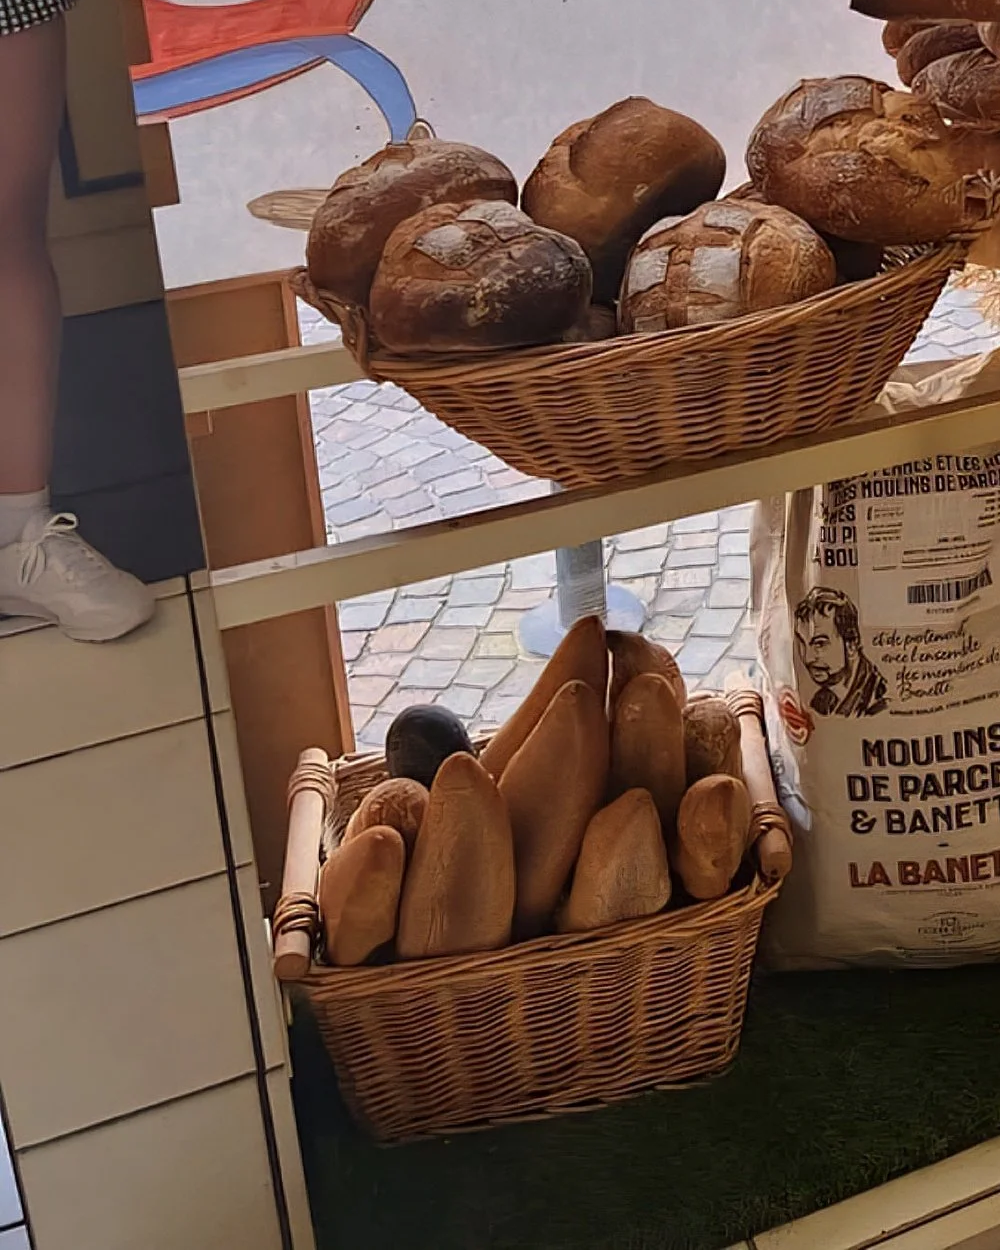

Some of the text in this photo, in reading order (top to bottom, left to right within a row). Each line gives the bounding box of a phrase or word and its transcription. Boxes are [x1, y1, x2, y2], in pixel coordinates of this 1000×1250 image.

[861, 474, 930, 499] MOULINS
[935, 474, 956, 492] DE
[846, 774, 892, 803] DE
[850, 808, 877, 835] &
[848, 860, 892, 888] LA
